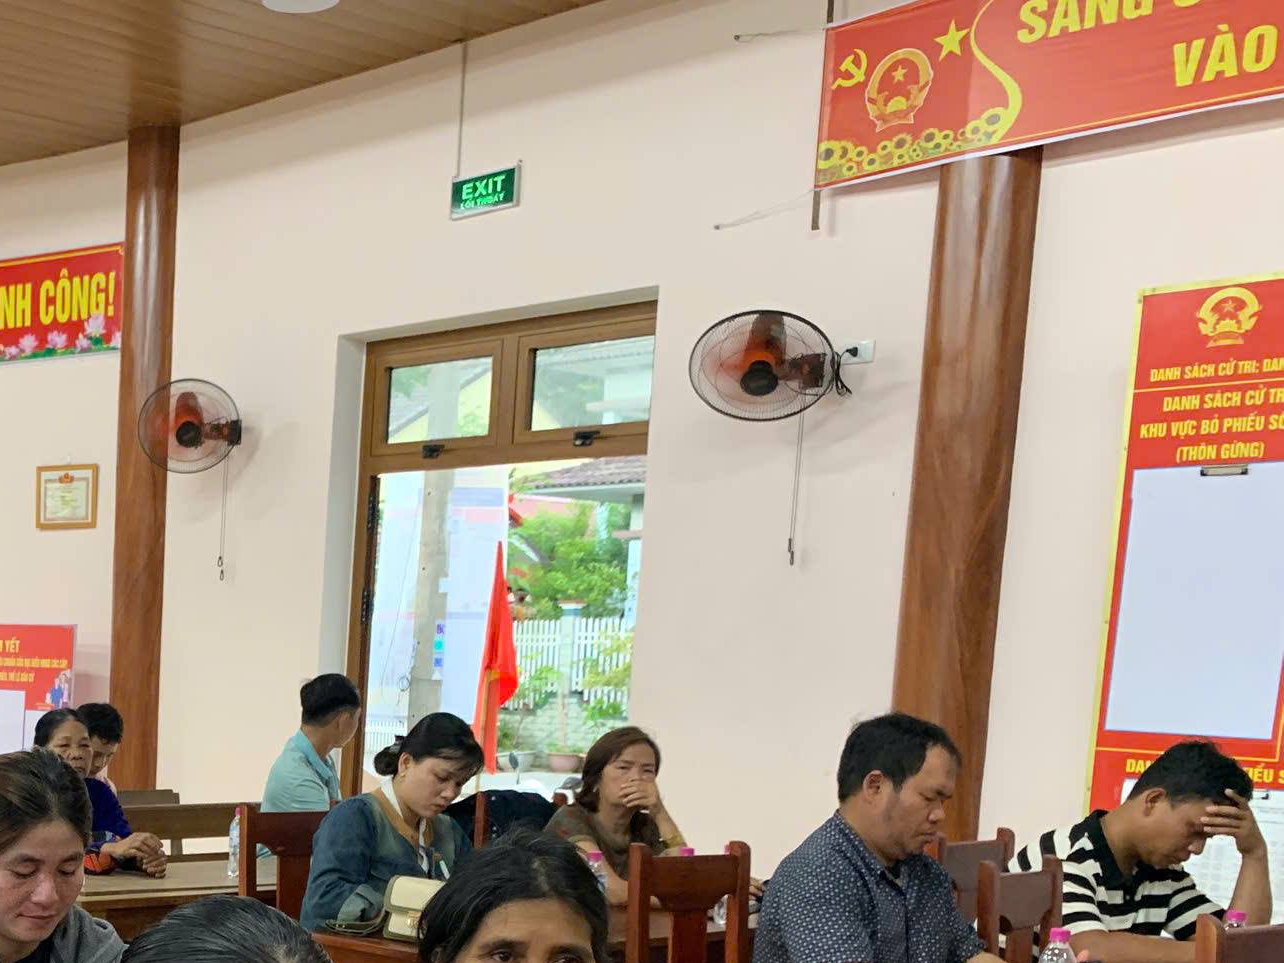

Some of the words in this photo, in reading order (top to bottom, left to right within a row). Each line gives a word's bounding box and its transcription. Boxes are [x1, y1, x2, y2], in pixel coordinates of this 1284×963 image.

[1173, 24, 1278, 87] VÀO
[462, 175, 506, 200] EXIT
[40, 268, 116, 321] CÔNG!
[1150, 367, 1181, 382] DANH
[1184, 362, 1215, 379] SÁCH
[1163, 395, 1200, 412] DANH
[1203, 390, 1242, 409] SÁCH
[1245, 384, 1267, 406] CỬ
[1140, 422, 1167, 439] KHU
[1171, 419, 1198, 440] VỰC
[1200, 414, 1219, 435] BỎ
[1222, 411, 1265, 433] PHIẾU
